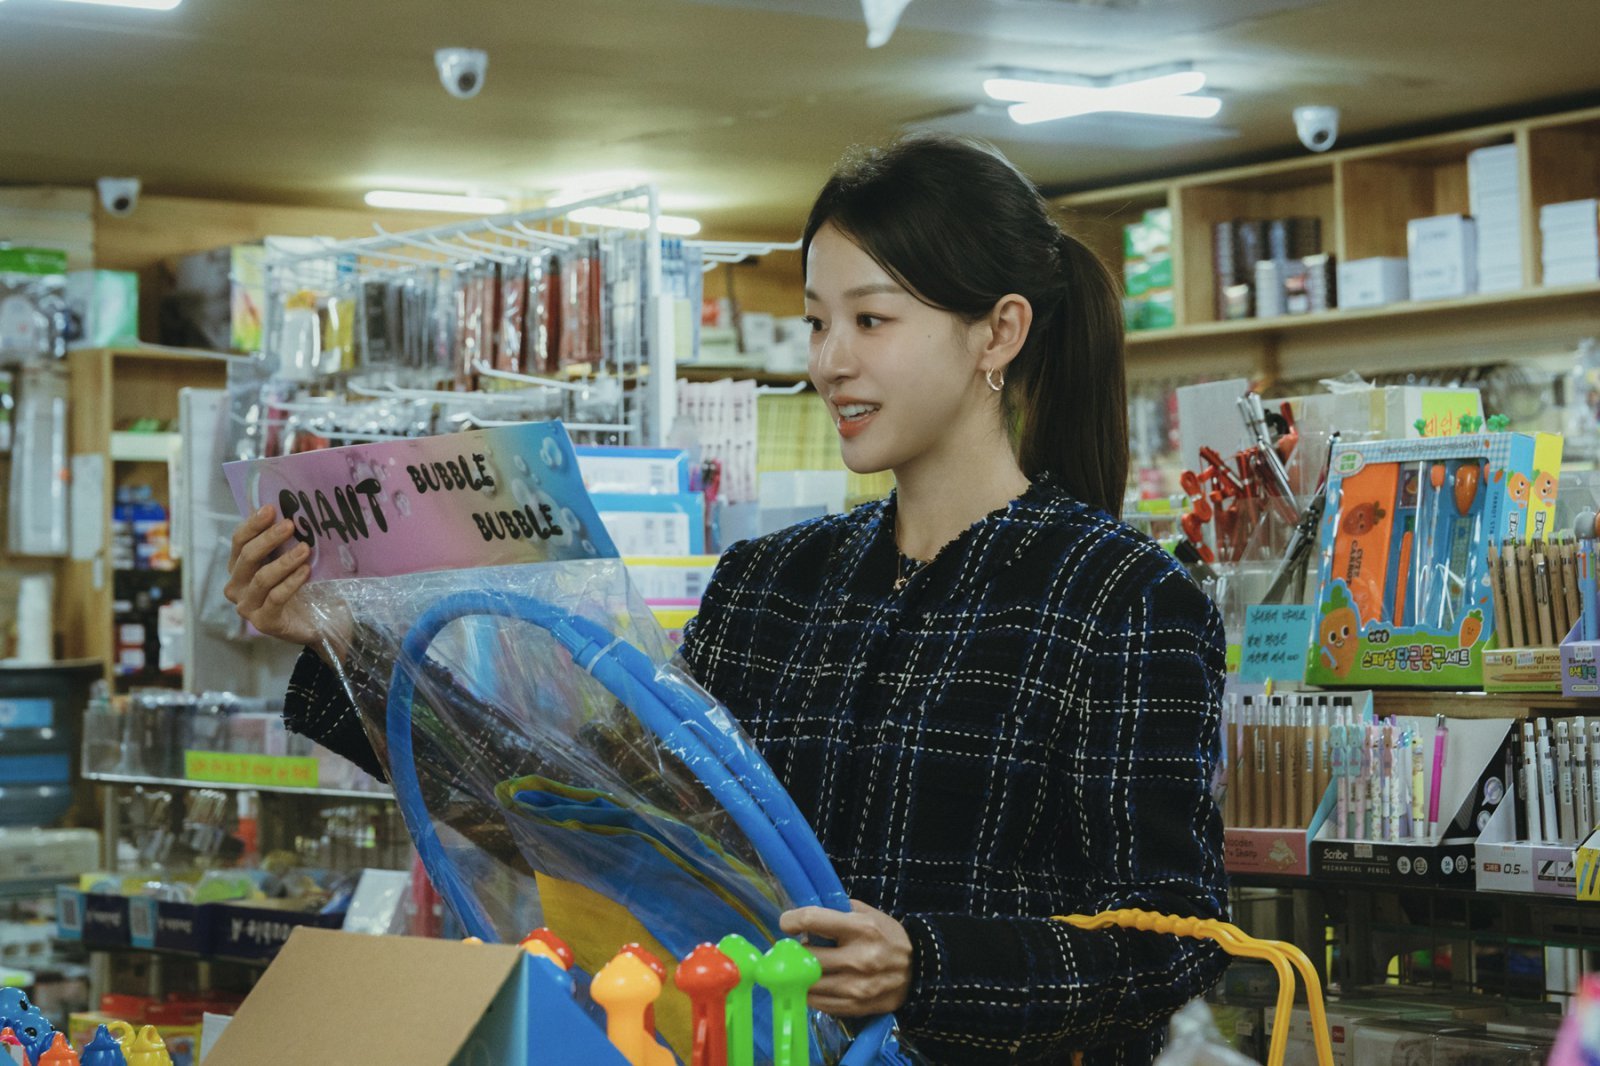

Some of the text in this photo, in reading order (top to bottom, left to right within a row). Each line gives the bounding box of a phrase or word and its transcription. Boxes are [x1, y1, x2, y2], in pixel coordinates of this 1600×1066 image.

[279, 453, 494, 548] GIANT BUBBLE
[472, 503, 563, 542] BUBBLE
[1323, 848, 1349, 860] Scribe
[1322, 865, 1391, 875] MECHANICAL PENCIL
[1503, 863, 1521, 875] 0.5
